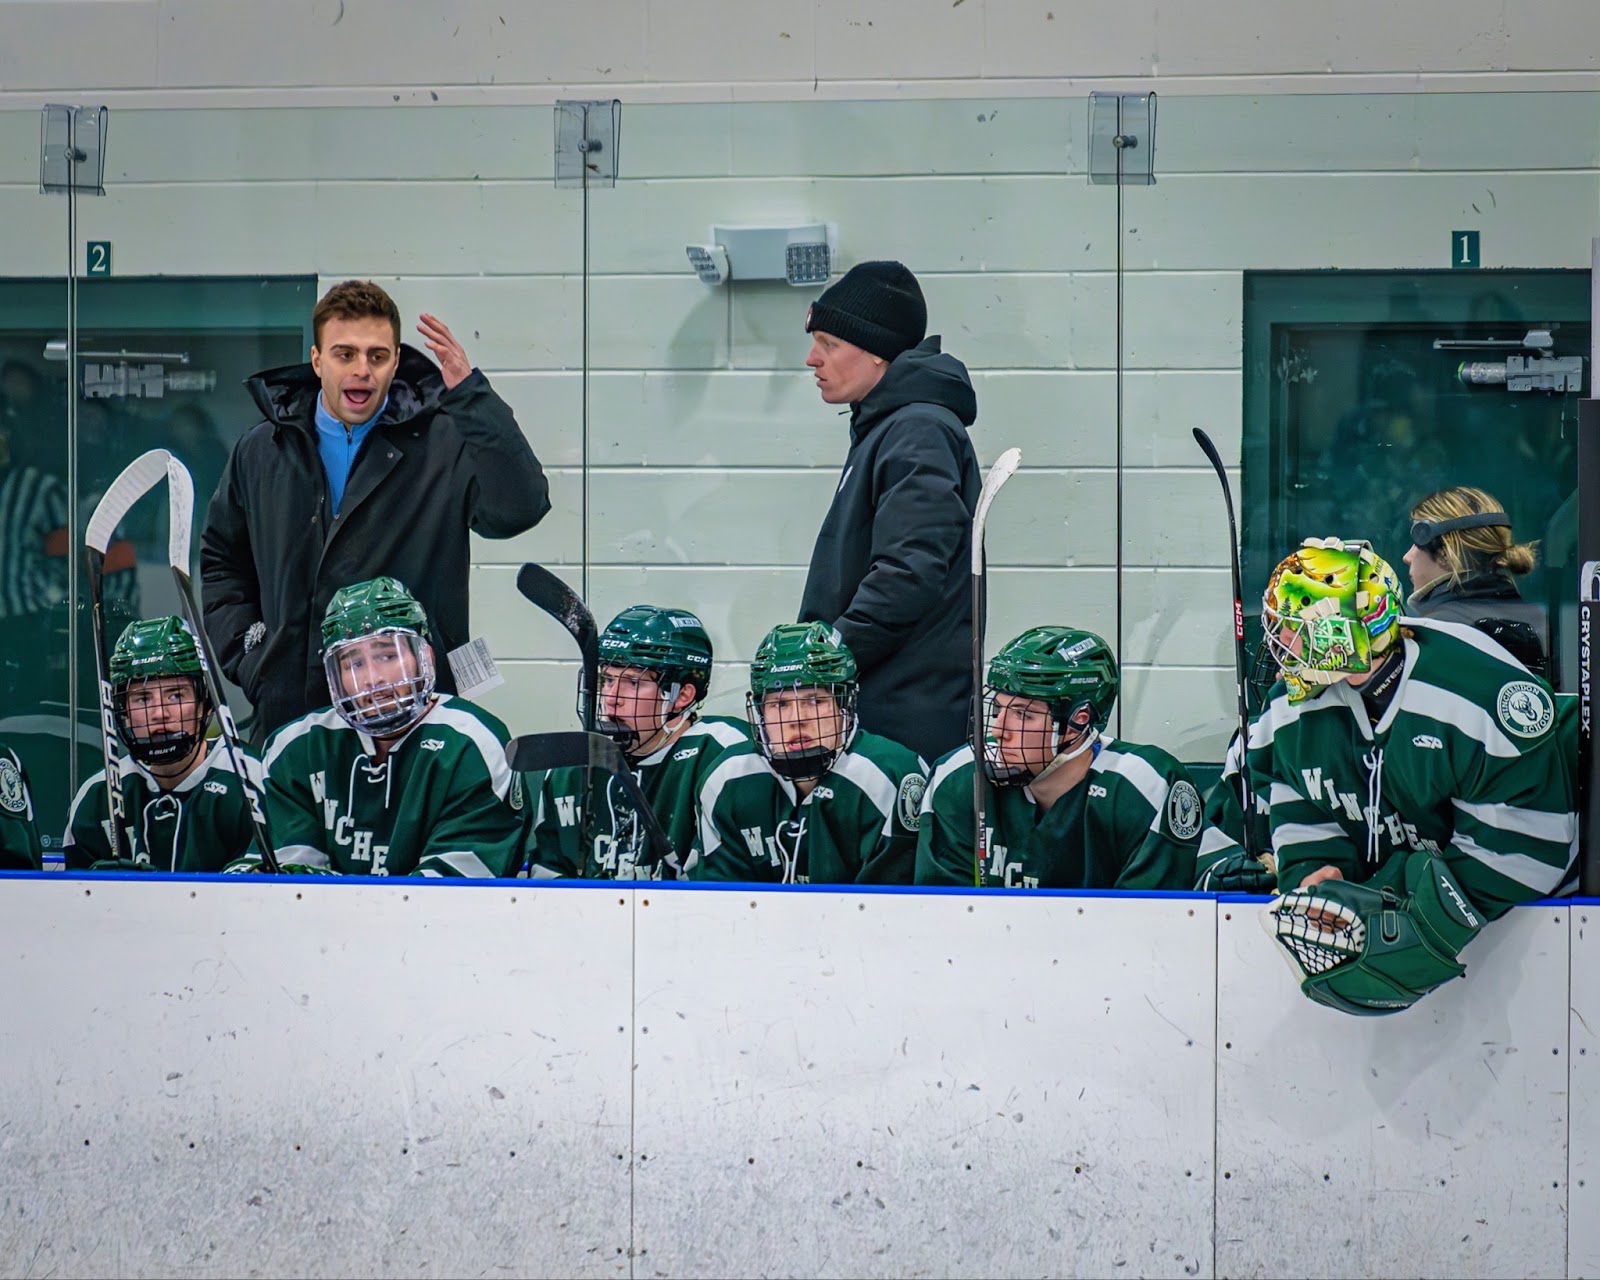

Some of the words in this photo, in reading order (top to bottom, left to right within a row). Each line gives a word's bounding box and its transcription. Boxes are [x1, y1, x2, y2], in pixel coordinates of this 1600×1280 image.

[91, 244, 106, 272] 2
[1460, 235, 1471, 263] 1
[1235, 602, 1243, 636] CCM
[602, 639, 630, 649] CCM
[686, 654, 708, 664] CCM
[1581, 605, 1591, 733] CRYSTAPLEX
[1501, 684, 1541, 721] WINCHENDON
[1522, 708, 1551, 733] SCHOOL
[101, 679, 125, 820] BAUER
[218, 704, 267, 825] CCM
[1440, 875, 1479, 928] TRUE
